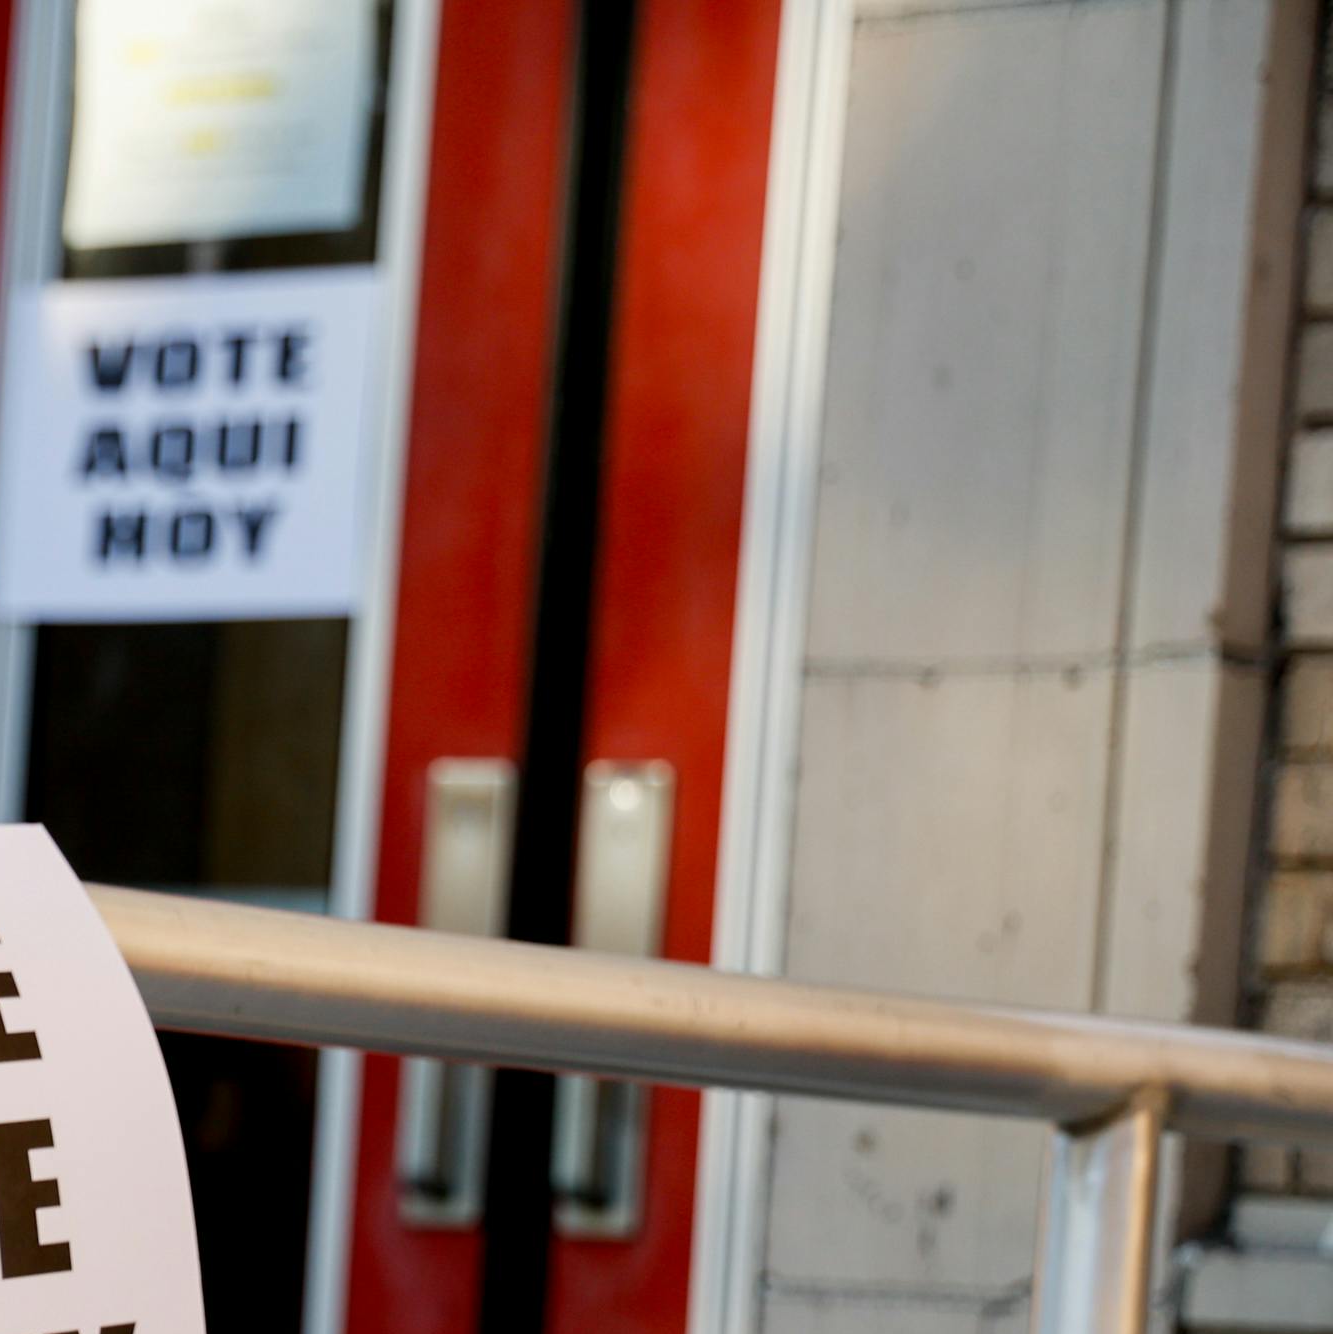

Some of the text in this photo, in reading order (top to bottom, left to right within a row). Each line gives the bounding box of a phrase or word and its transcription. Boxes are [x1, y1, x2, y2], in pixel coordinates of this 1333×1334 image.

[83, 322, 313, 391] VOTE
[78, 417, 303, 483] AQUI
[93, 502, 279, 565] HOY
